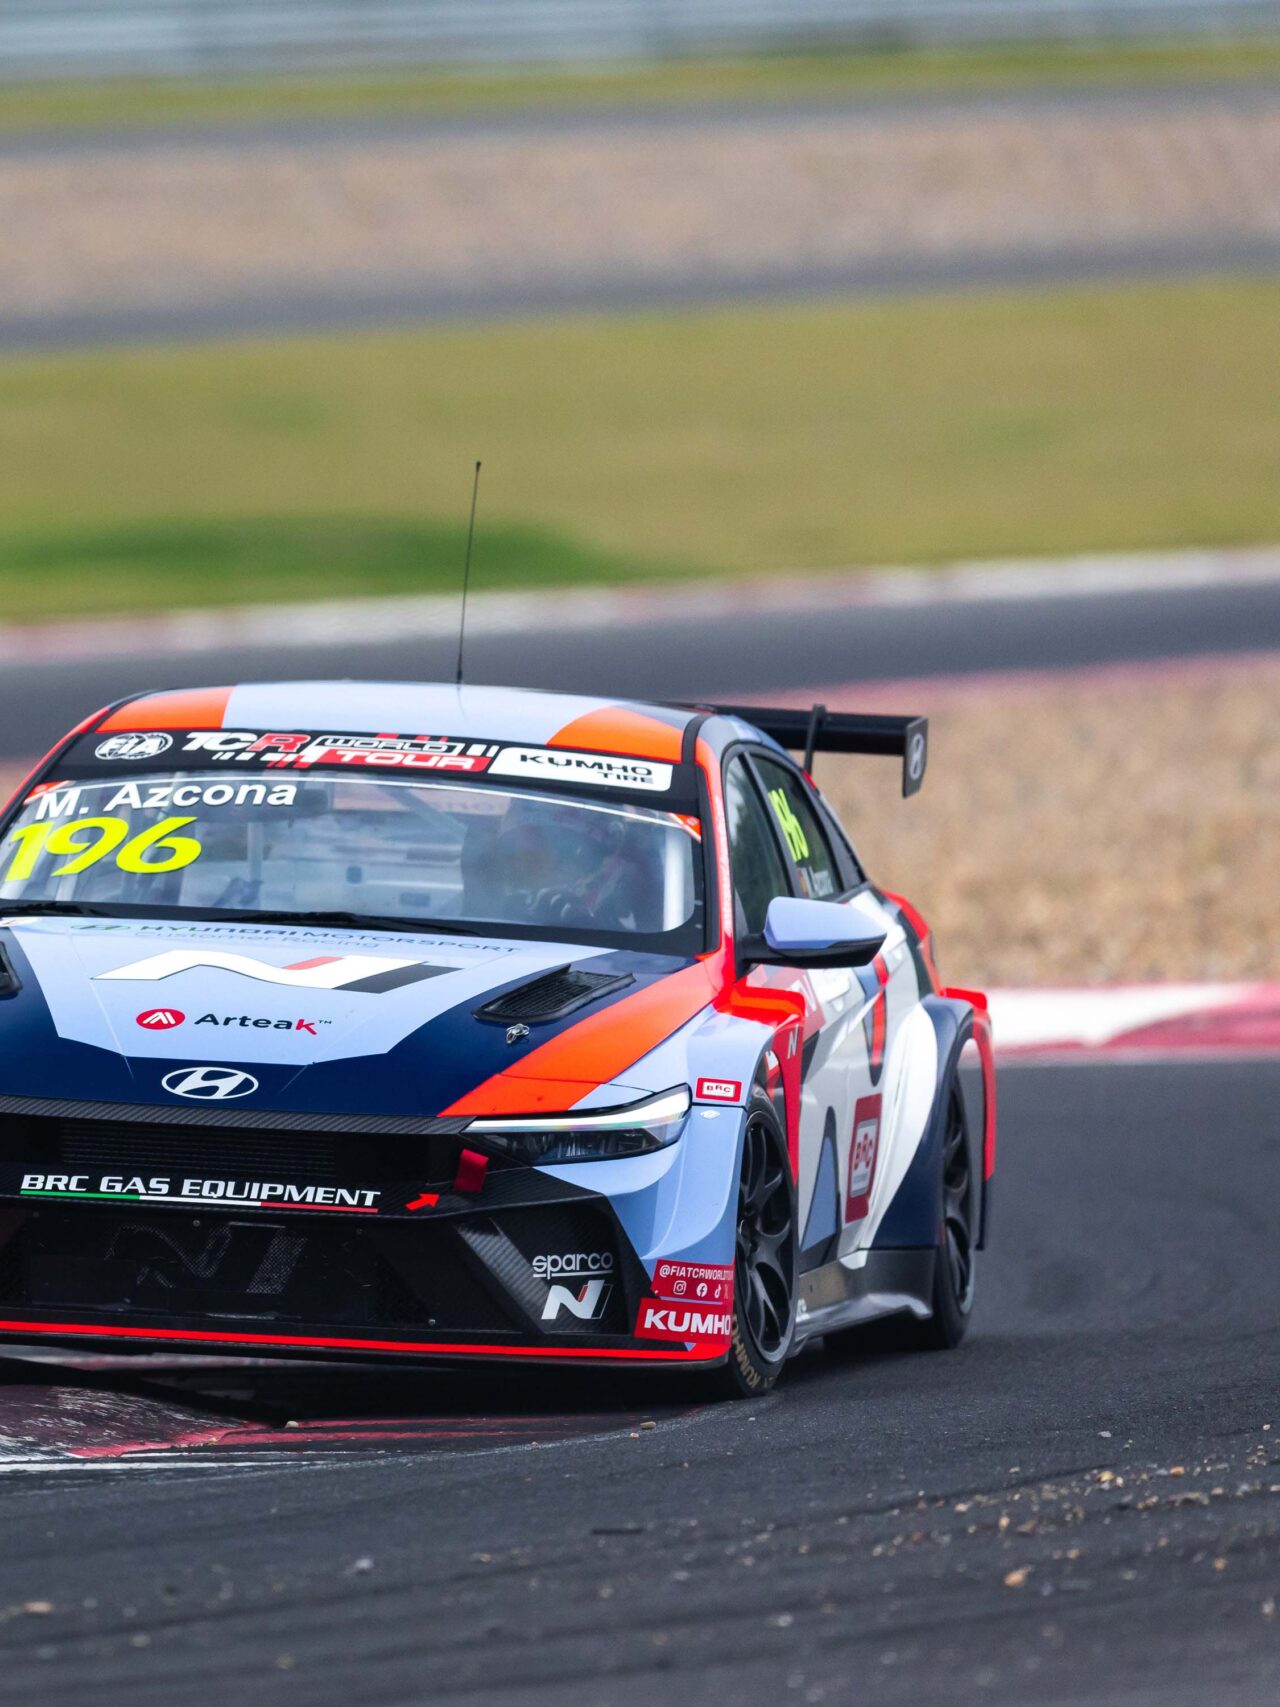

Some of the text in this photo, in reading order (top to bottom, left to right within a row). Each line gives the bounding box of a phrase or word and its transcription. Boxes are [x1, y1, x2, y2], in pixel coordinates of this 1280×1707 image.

[99, 738, 162, 752] FIA
[182, 732, 311, 752] TCR
[324, 736, 449, 752] WORLD
[335, 751, 476, 770] TOUR
[520, 754, 653, 776] KUMHO
[597, 772, 654, 785] TIRE
[35, 783, 298, 821] M. Azcona
[4, 816, 202, 882] 196
[194, 1013, 318, 1036] Arteak
[706, 1084, 731, 1094] BRC
[21, 1174, 381, 1207] BRC GAS EQUIPMENT
[532, 1251, 614, 1280] sparco
[644, 1308, 731, 1336] KUMHO
